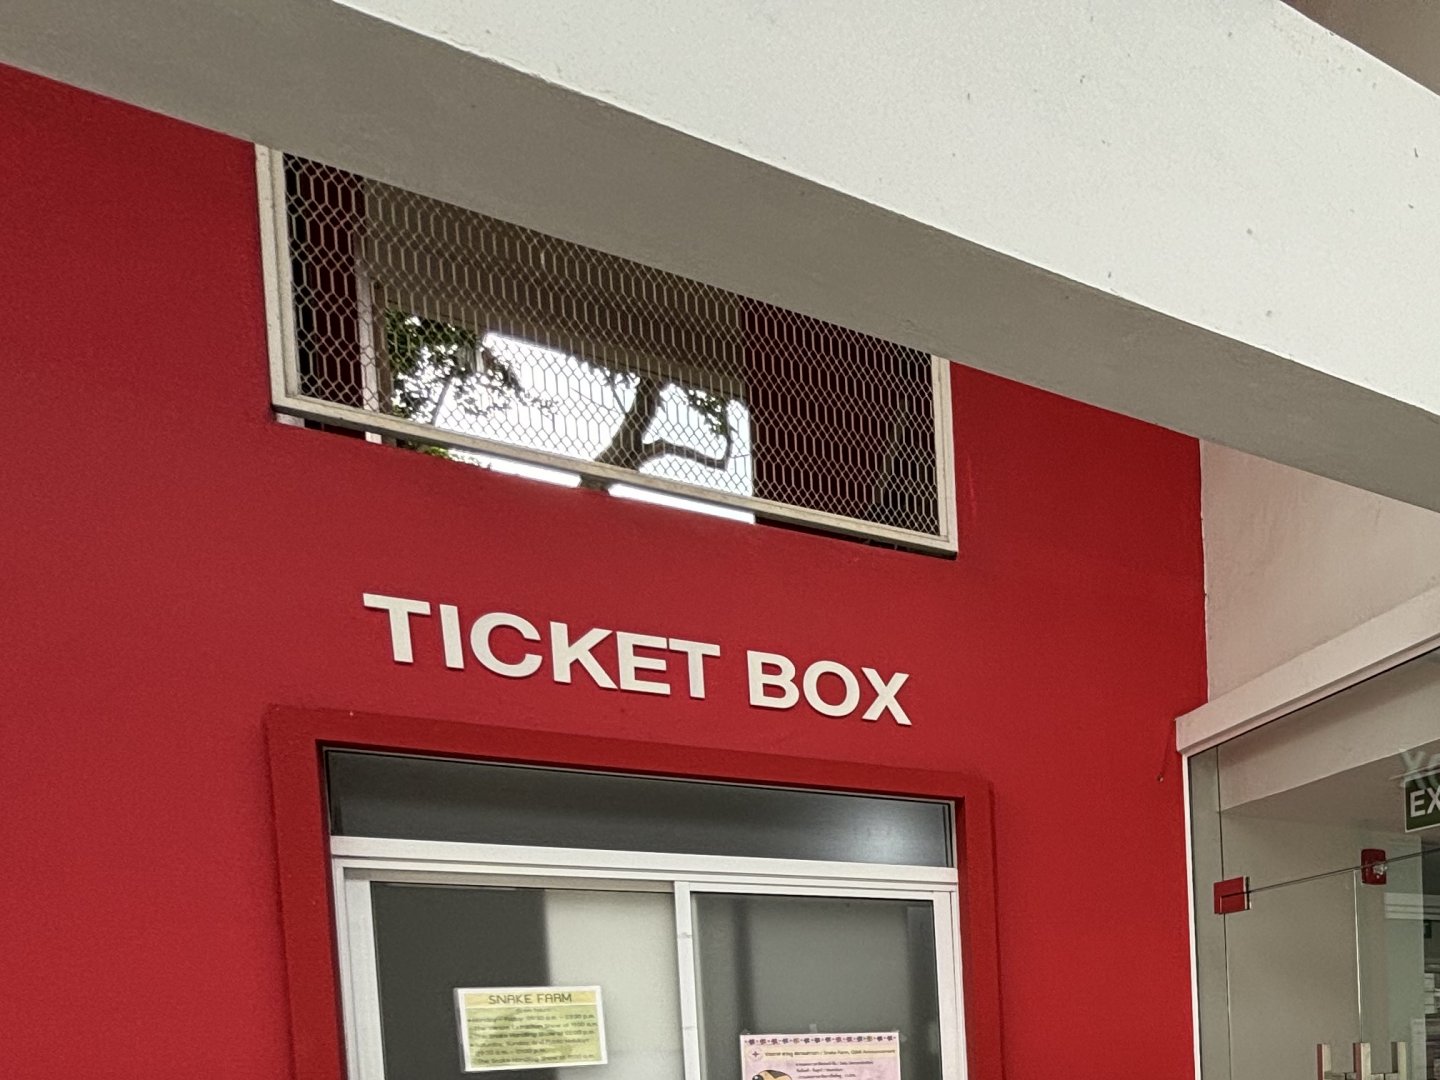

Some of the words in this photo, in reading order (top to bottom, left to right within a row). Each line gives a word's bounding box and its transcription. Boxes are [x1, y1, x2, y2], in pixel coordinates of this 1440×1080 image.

[363, 592, 720, 699] TICKET
[747, 649, 912, 726] BOX
[488, 993, 533, 1005] SNAKE
[536, 992, 573, 1004] FARM
